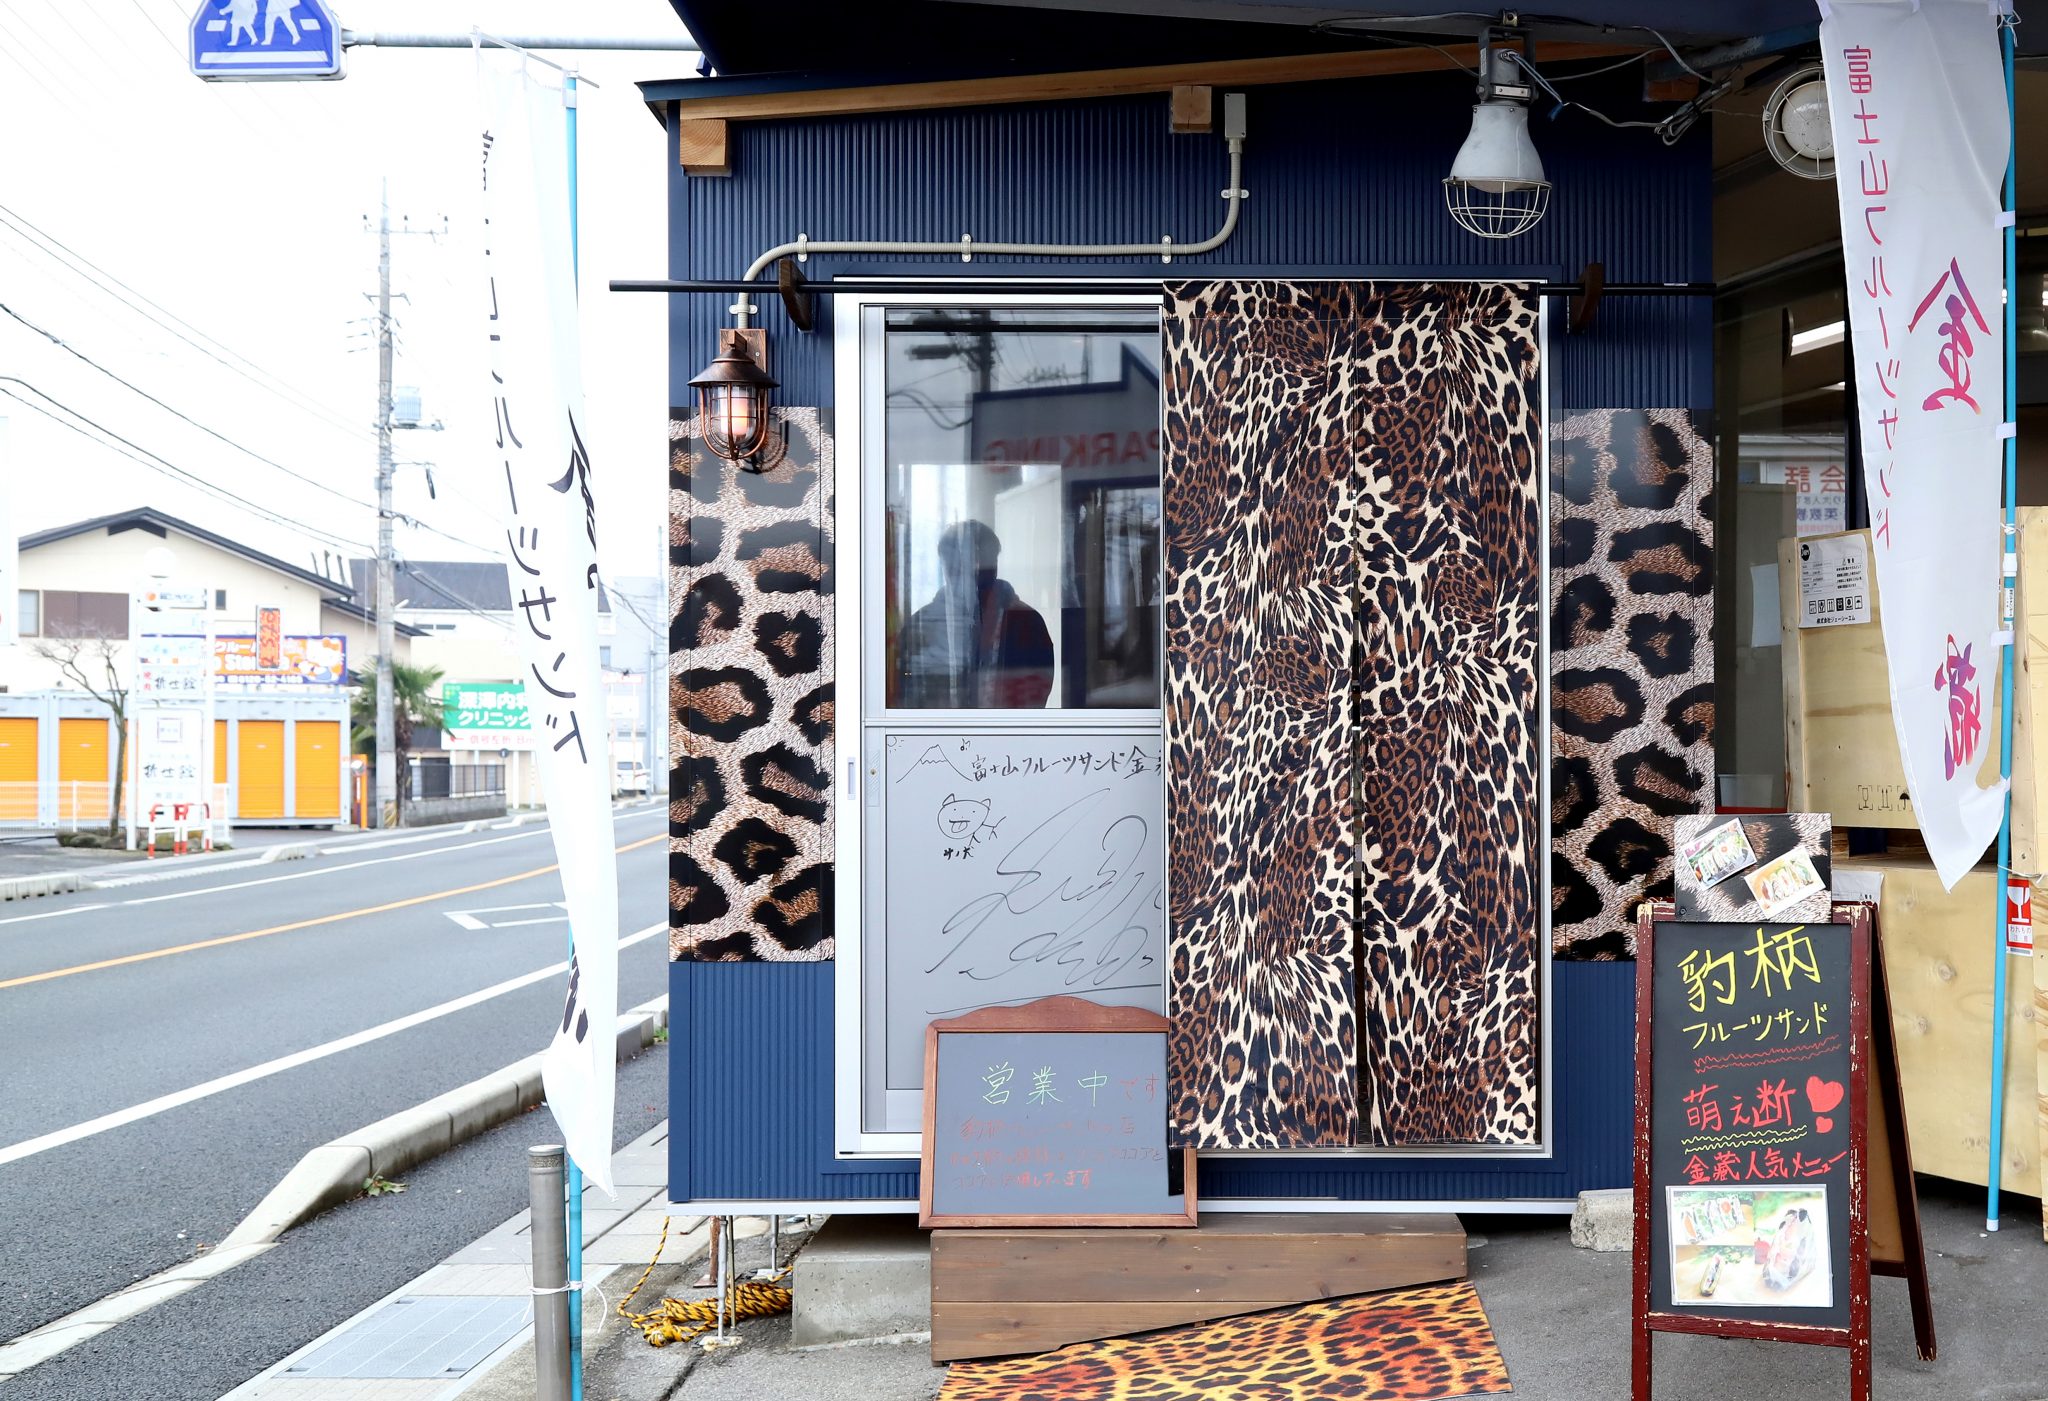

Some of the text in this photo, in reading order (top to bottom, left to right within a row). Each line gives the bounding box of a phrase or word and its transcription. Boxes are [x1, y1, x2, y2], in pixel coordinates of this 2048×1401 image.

[1677, 925, 1821, 1013] 豹柄
[1682, 1001, 1828, 1049] フルーツサンド
[1683, 1078, 1797, 1132] 萌え断
